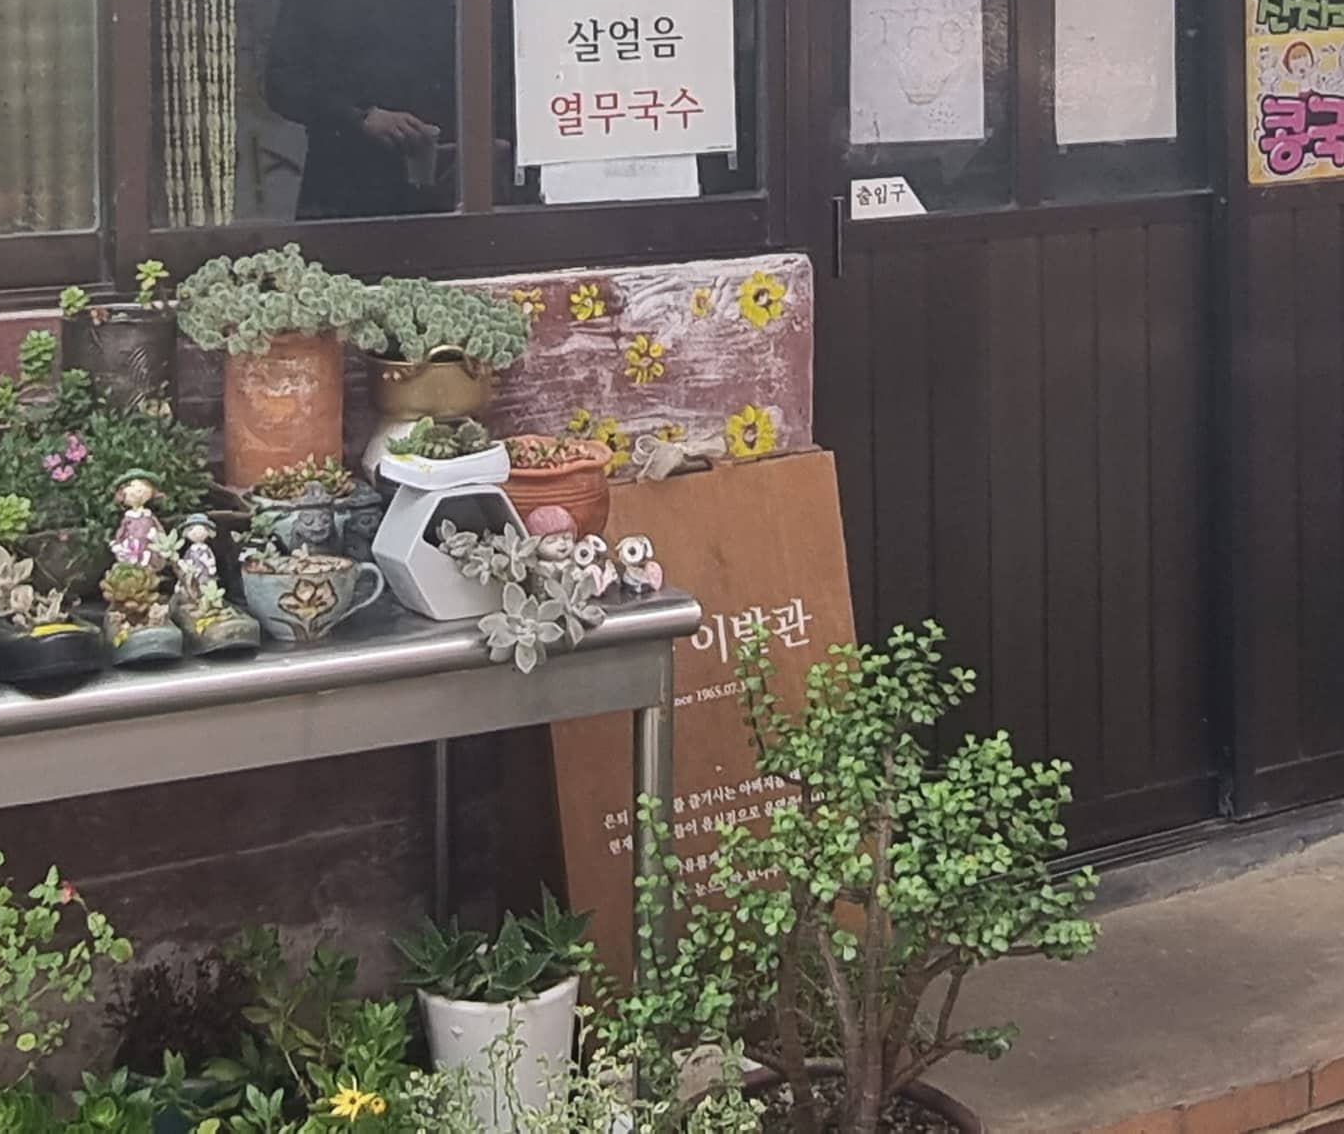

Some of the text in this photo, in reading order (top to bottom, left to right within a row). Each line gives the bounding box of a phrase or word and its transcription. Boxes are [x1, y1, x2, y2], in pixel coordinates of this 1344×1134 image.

[567, 16, 683, 63] 살얼음
[551, 88, 704, 137] 열무국수
[856, 183, 907, 206] 출입구
